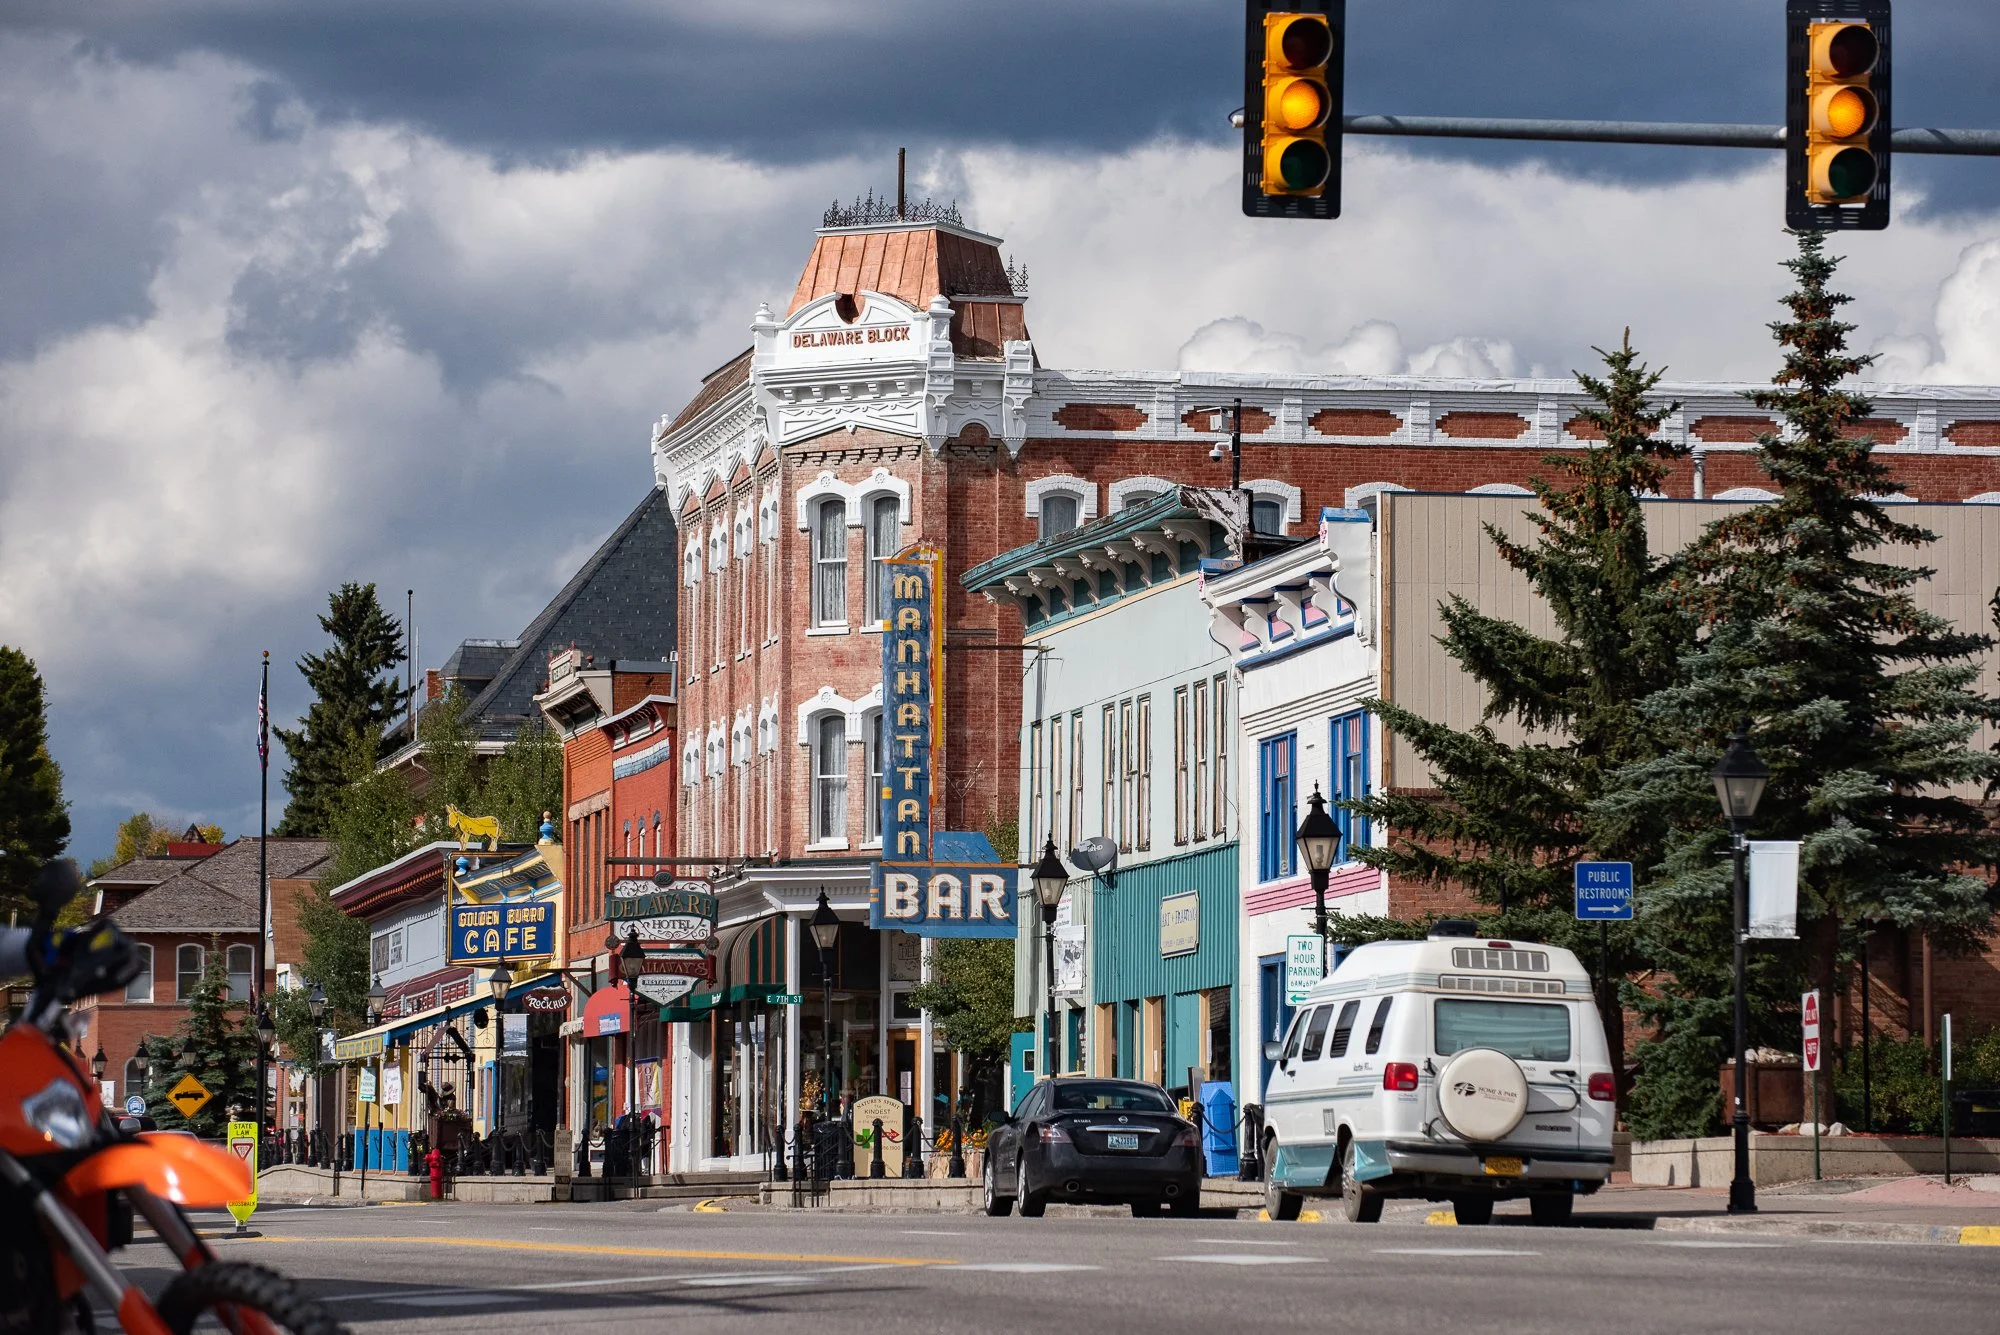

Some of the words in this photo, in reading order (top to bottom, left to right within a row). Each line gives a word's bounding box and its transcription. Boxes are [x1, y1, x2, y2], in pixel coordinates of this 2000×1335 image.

[793, 331, 863, 348] DELAWARE
[867, 327, 910, 343] BLOCK
[894, 573, 923, 855] MANHATTAN
[1588, 871, 1620, 882] PUBLIC
[884, 873, 1010, 919] BAR
[1579, 888, 1630, 899] RESTROOMS
[610, 893, 713, 918] DELAWARE
[458, 910, 500, 927] GOLDEN
[506, 906, 545, 924] BURRO
[652, 919, 695, 930] HOTEL
[464, 926, 537, 953] CAFE
[1298, 941, 1313, 950] TWO
[1294, 954, 1315, 963] HOUR
[1289, 966, 1320, 976] PARKING
[767, 995, 771, 1003] E
[776, 995, 789, 1003] 7TH
[793, 995, 802, 1003] ST
[644, 1066, 653, 1101] OPEN
[856, 1099, 882, 1109] NATURE'S
[883, 1099, 900, 1110] SPIRIT
